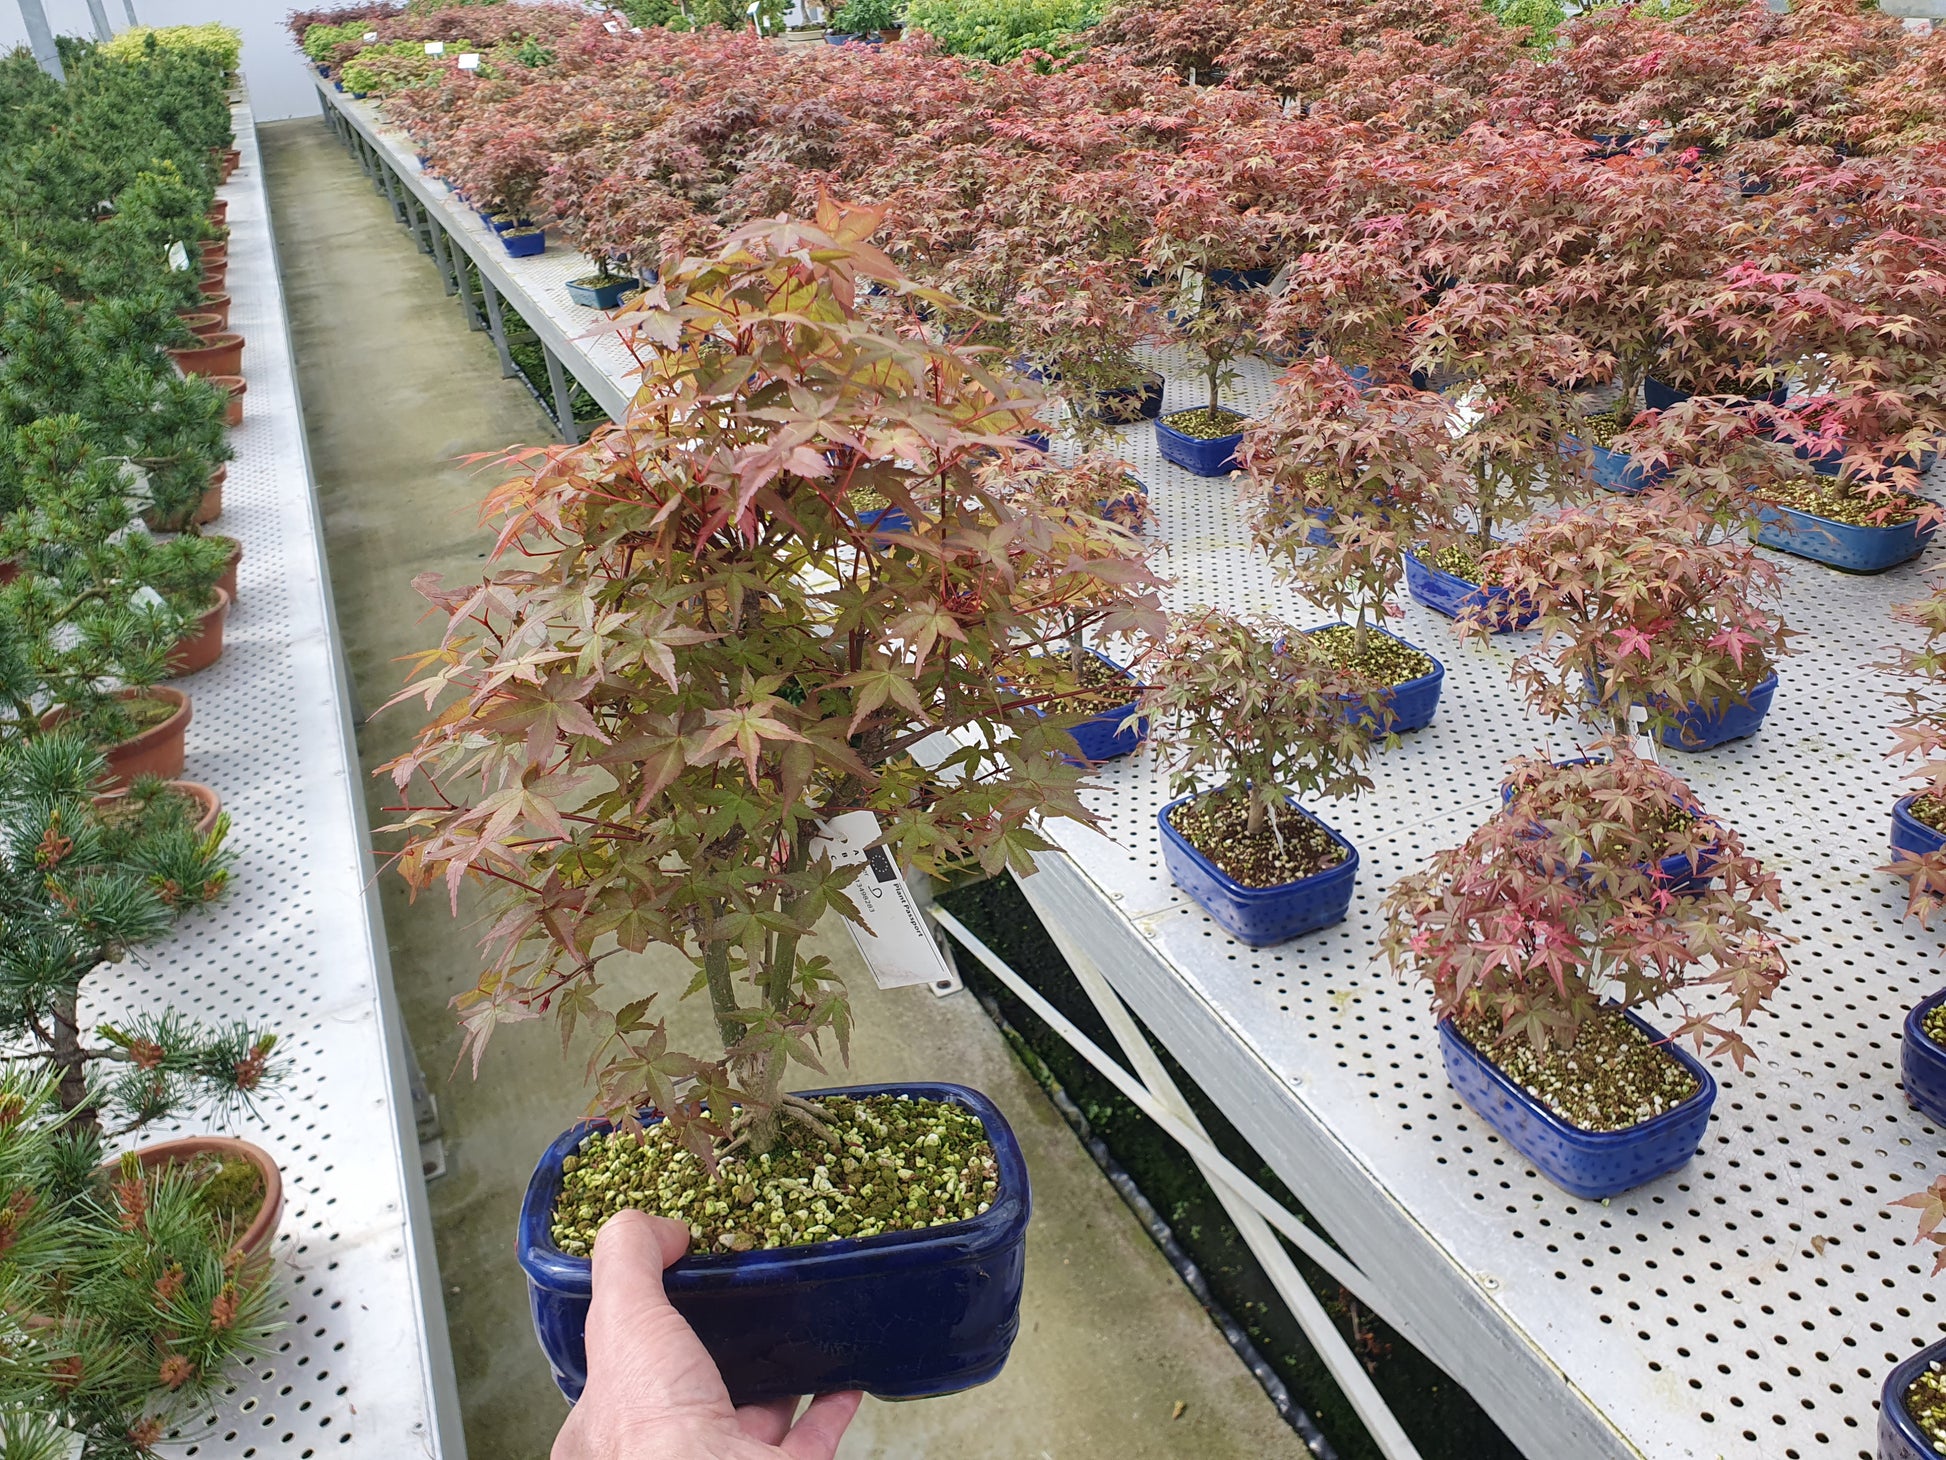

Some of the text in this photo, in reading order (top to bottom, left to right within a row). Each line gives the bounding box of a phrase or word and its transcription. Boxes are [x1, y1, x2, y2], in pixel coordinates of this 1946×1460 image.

[856, 879, 875, 912] 13498283
[893, 883, 923, 937] Plant Passport
